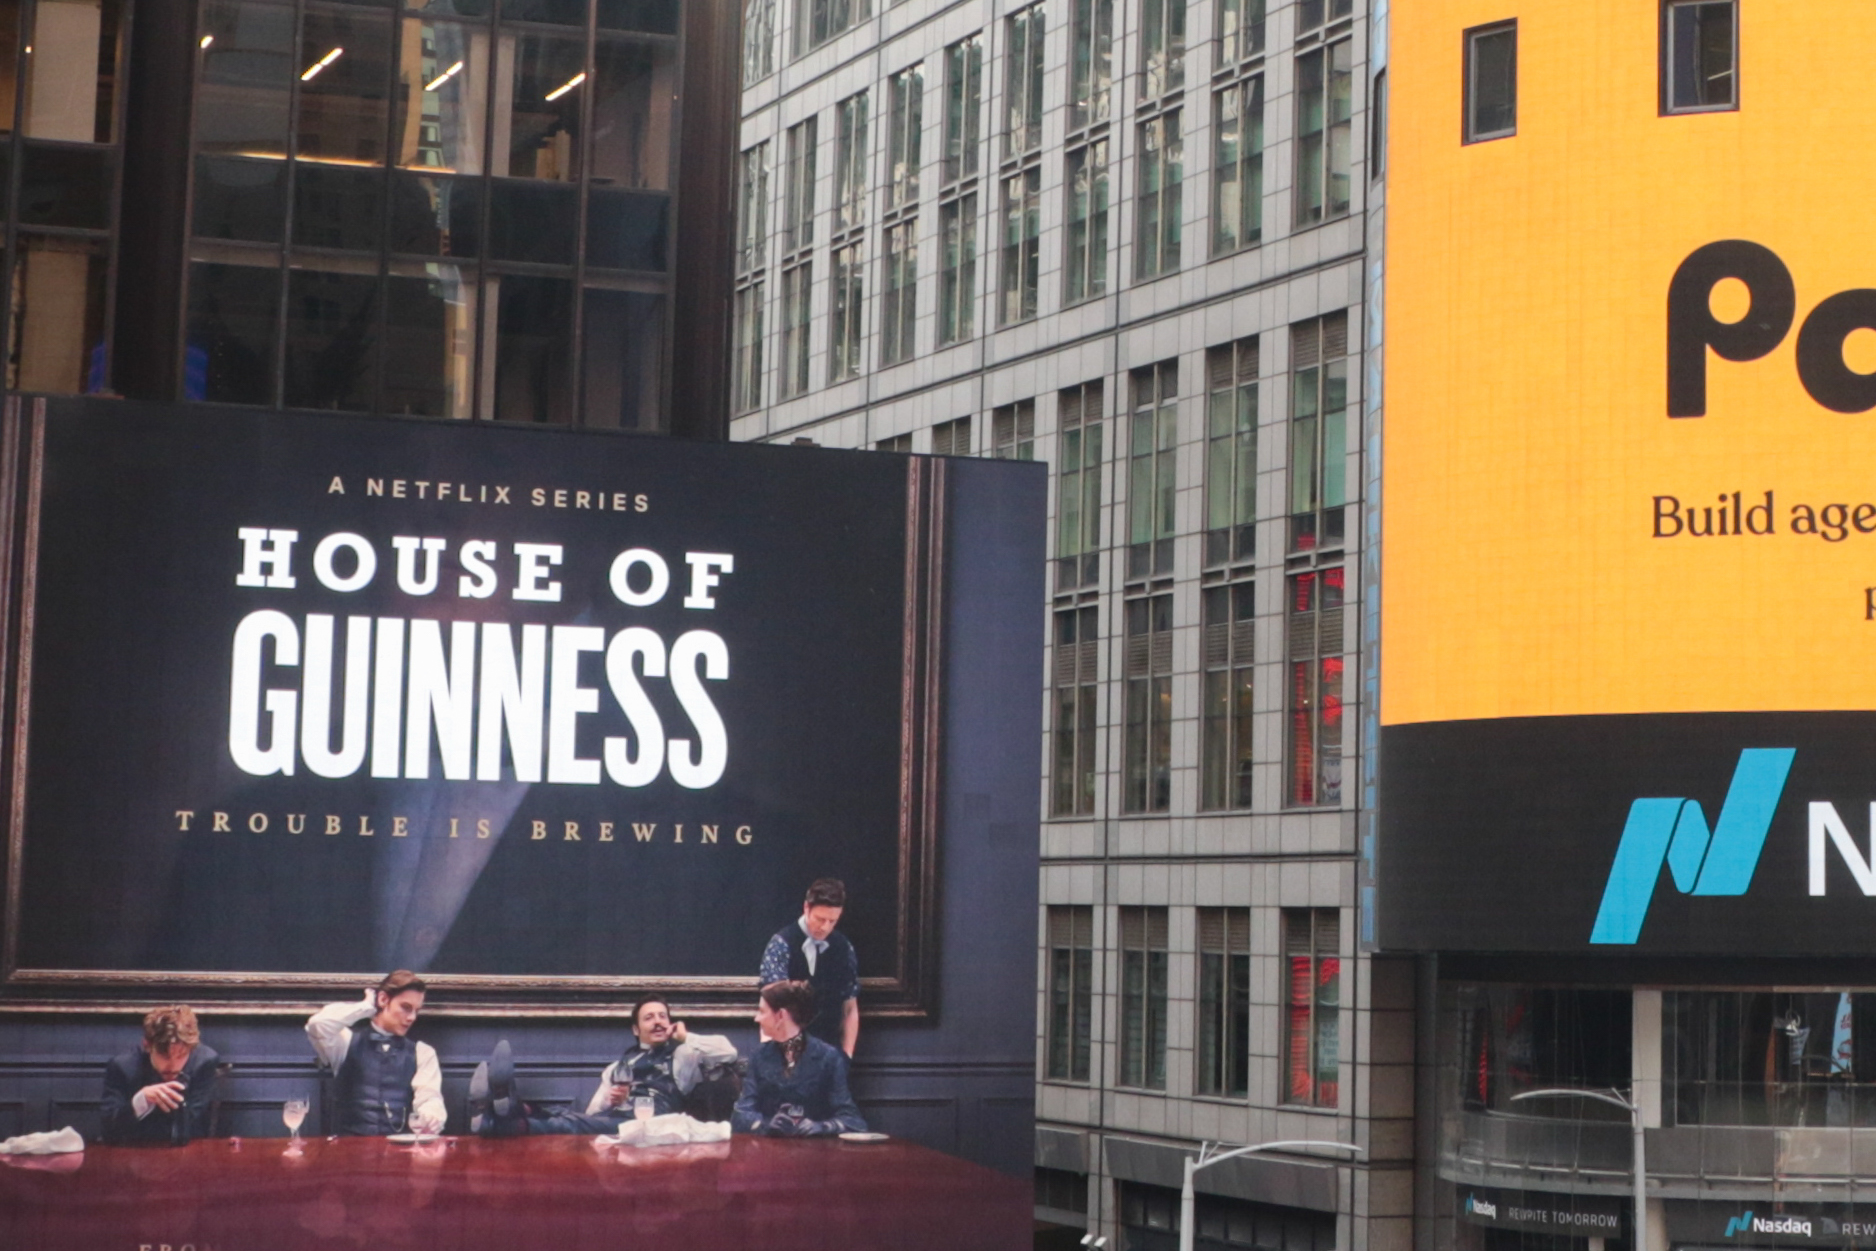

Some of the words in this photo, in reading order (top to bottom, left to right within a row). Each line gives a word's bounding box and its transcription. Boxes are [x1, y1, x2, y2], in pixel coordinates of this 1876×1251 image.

[328, 476, 346, 495] A
[366, 478, 511, 505] NETFLIX
[531, 487, 649, 513] SERIES
[1651, 490, 1776, 538] Build
[236, 527, 563, 602] HOUSE
[609, 548, 734, 610] OF
[228, 608, 730, 790] GUINNESS
[175, 810, 409, 838] TROUBLE
[449, 817, 491, 840] IS
[531, 820, 754, 845] BREWING
[1552, 1210, 1619, 1228] TOMORROW
[1752, 1217, 1812, 1238] Nasdaq
